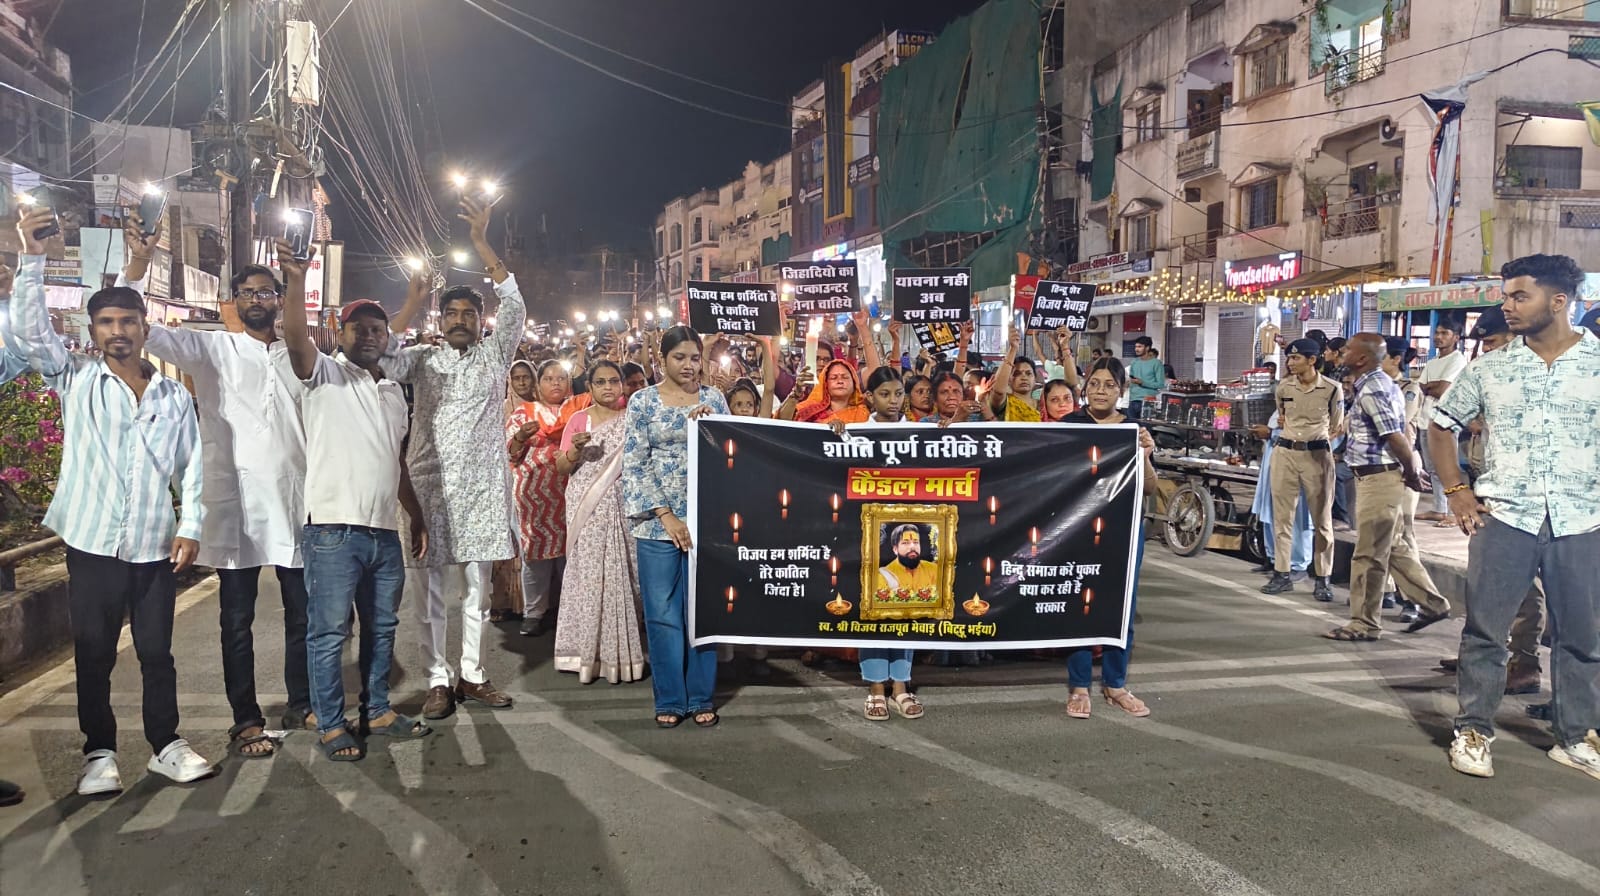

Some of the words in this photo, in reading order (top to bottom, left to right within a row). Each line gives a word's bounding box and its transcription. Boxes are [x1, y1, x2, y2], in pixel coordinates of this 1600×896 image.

[782, 265, 836, 279] जिहादियो
[838, 266, 854, 277] का
[1225, 260, 1298, 288] Trendsetter-01
[895, 276, 940, 287] याचना
[942, 272, 969, 286] नही
[689, 288, 718, 300] विजय
[720, 292, 734, 300] हम
[736, 290, 768, 302] शर्मिंदा
[768, 290, 777, 302] है
[796, 283, 848, 294] एन्काउन्टर
[818, 296, 852, 309] चाहिये
[920, 292, 946, 304] अब
[1036, 296, 1062, 310] विजय
[710, 302, 724, 315] तेरे
[726, 304, 759, 316] कातिल
[903, 310, 926, 320] रण
[928, 306, 962, 319] होगा
[717, 318, 742, 330] जिंदा
[1030, 314, 1043, 326] को
[1066, 316, 1086, 328] मिले
[880, 434, 919, 464] पूर्ण
[924, 434, 978, 458] तरीके
[984, 434, 1004, 458] से
[852, 470, 920, 496] कैंडल
[925, 470, 976, 496] मार्च
[738, 546, 768, 560] विजय
[770, 549, 786, 560] हम
[788, 546, 820, 560] शर्मिंदा
[821, 545, 831, 560] है
[759, 564, 773, 579] तेरे
[775, 564, 810, 579] कातिल
[1001, 560, 1026, 581] हिन्दू
[1026, 565, 1058, 577] समाज
[1059, 562, 1076, 576] करें
[1076, 564, 1102, 580] पुकार
[764, 582, 790, 596] जिंदा
[1020, 584, 1038, 596] क्या
[1040, 584, 1055, 595] कर
[1057, 580, 1072, 594] रही
[1073, 580, 1082, 594] है
[1035, 602, 1066, 614] सरकार
[836, 620, 848, 632] श्री
[850, 620, 877, 632] विजय
[880, 622, 910, 637] राजपूत
